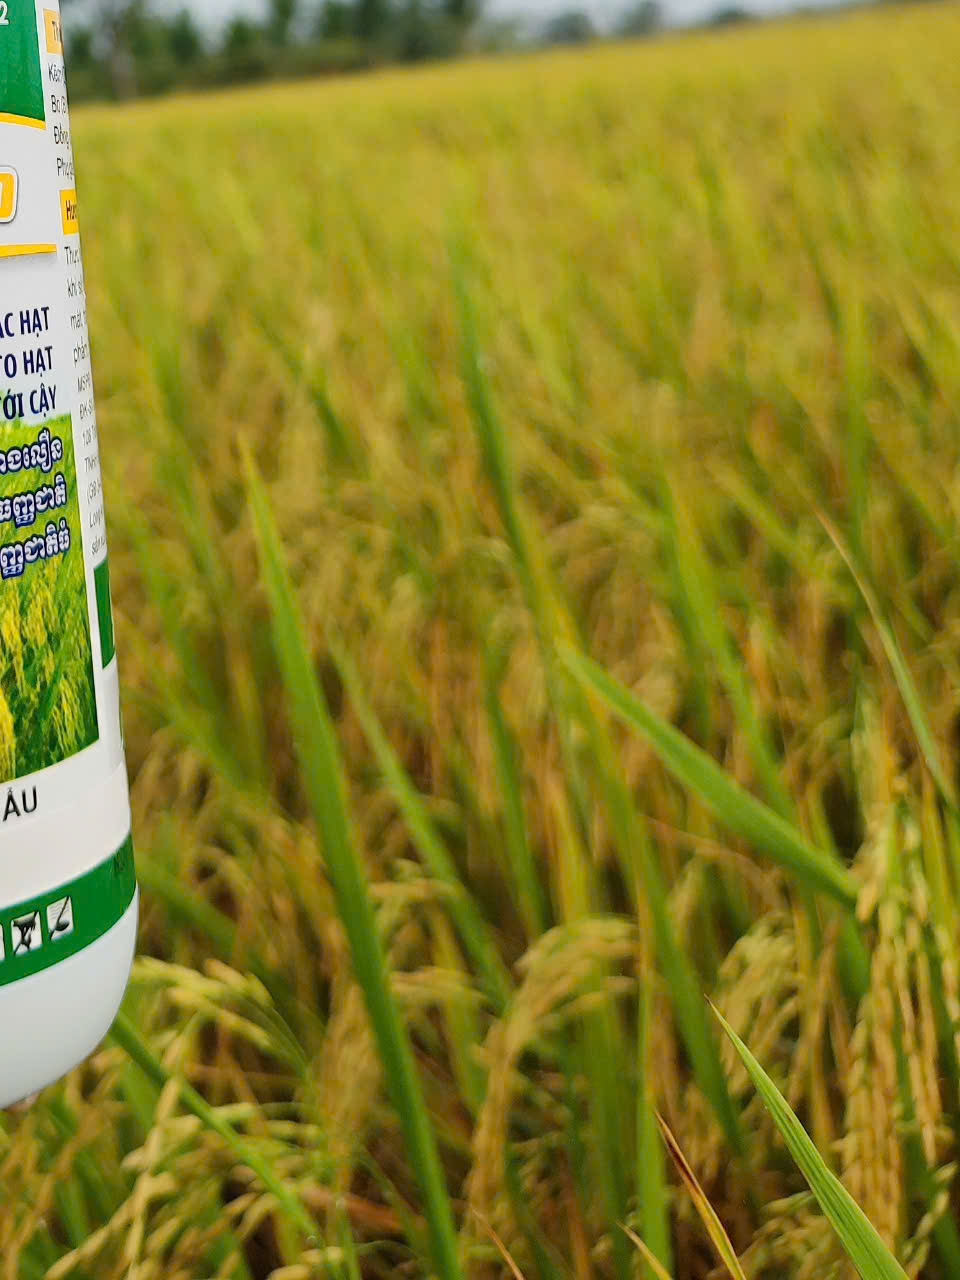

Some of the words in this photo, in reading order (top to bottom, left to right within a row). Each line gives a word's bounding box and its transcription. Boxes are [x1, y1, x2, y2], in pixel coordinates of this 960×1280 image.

[20, 306, 50, 338] HẠT
[23, 346, 53, 377] HẠT
[29, 383, 57, 418] CẬY
